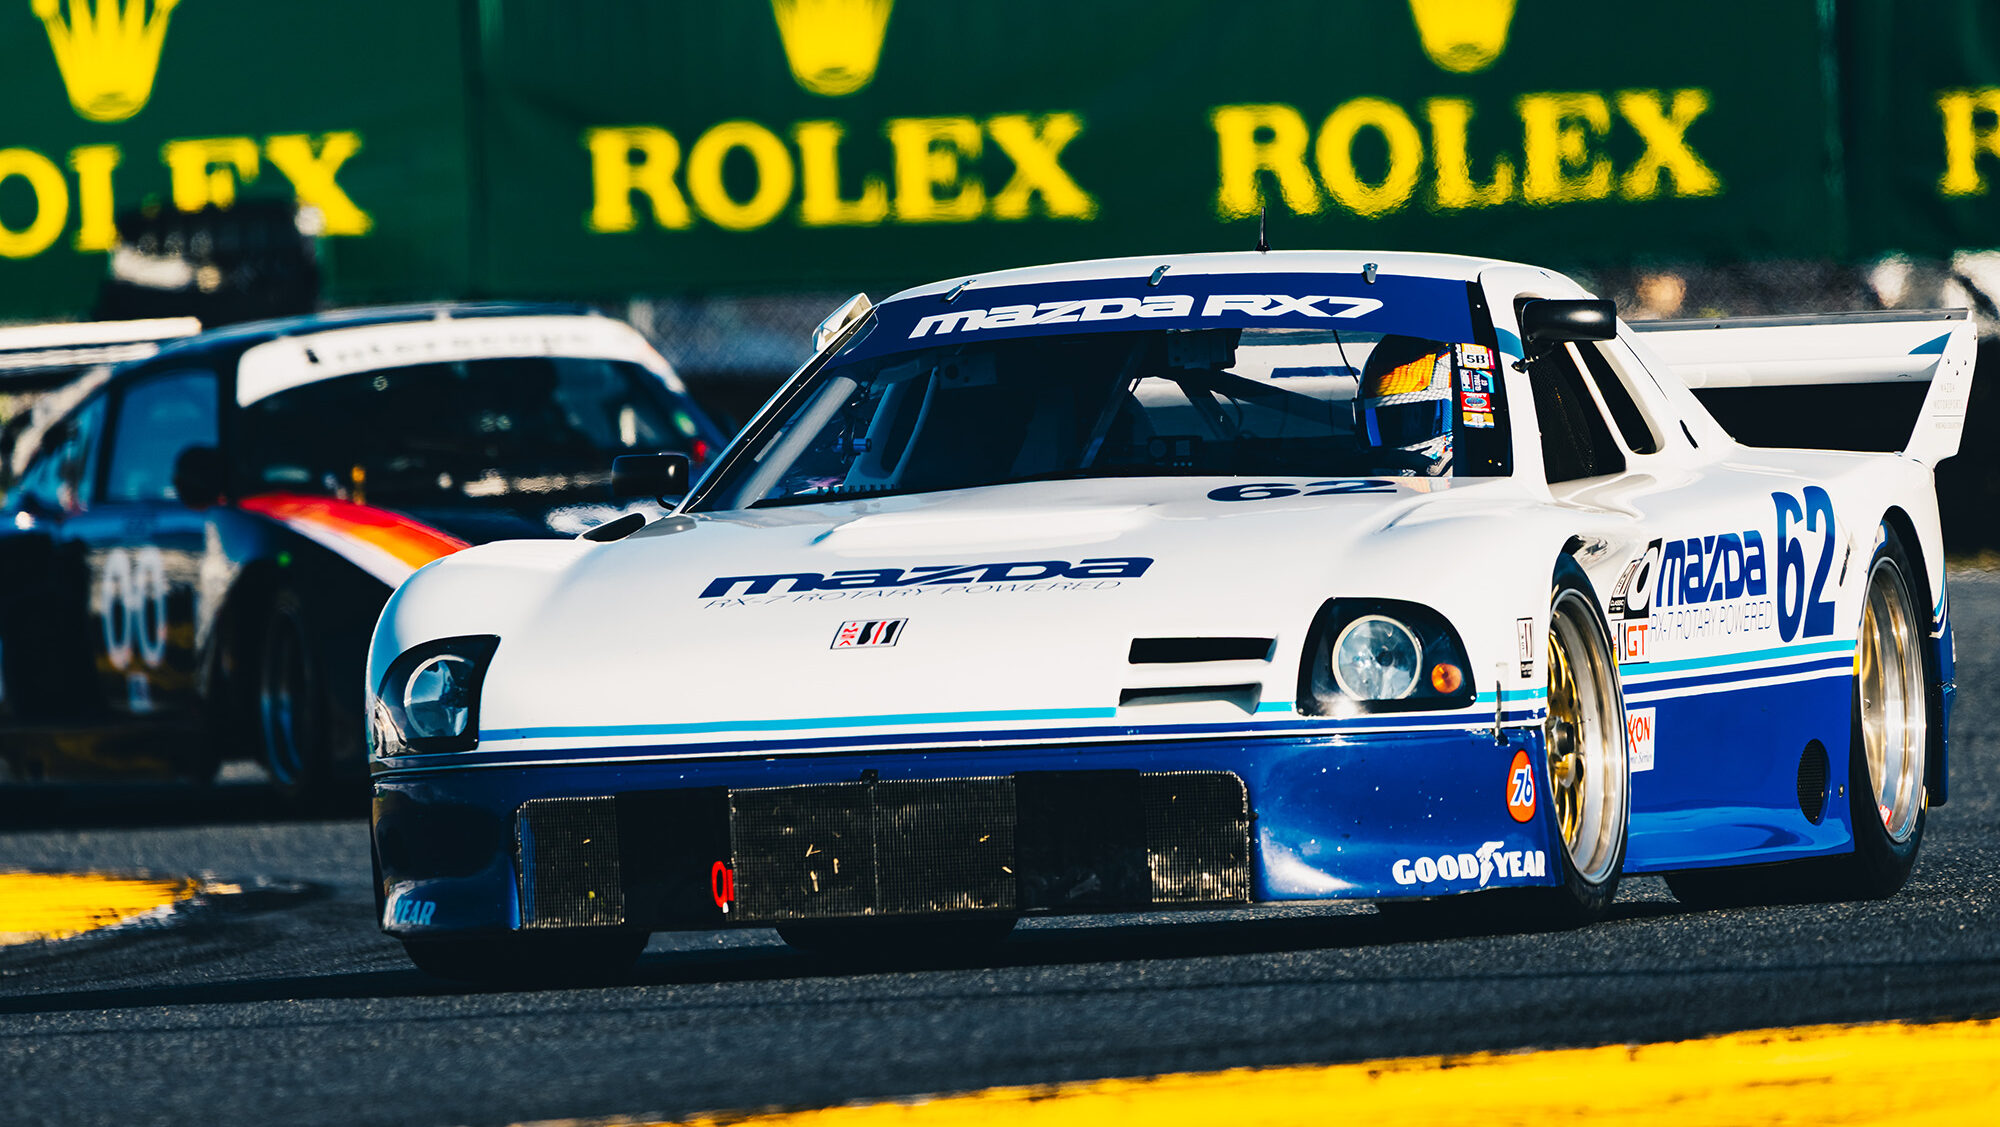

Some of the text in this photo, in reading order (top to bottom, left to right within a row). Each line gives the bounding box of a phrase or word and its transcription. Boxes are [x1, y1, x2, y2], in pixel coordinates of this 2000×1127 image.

[585, 113, 1097, 232] ROLEX
[1212, 90, 1721, 217] ROLEX
[1201, 294, 1384, 319] RX7
[1207, 480, 1397, 502] 62
[1771, 485, 1836, 643] 62
[792, 588, 926, 603] ROTARY
[941, 580, 1121, 596] POWERED
[1627, 624, 1648, 656] GT
[1650, 612, 1674, 643] RX-7
[1675, 607, 1716, 640] ROTARY
[1719, 600, 1774, 637] POWERED
[1510, 764, 1535, 807] 76
